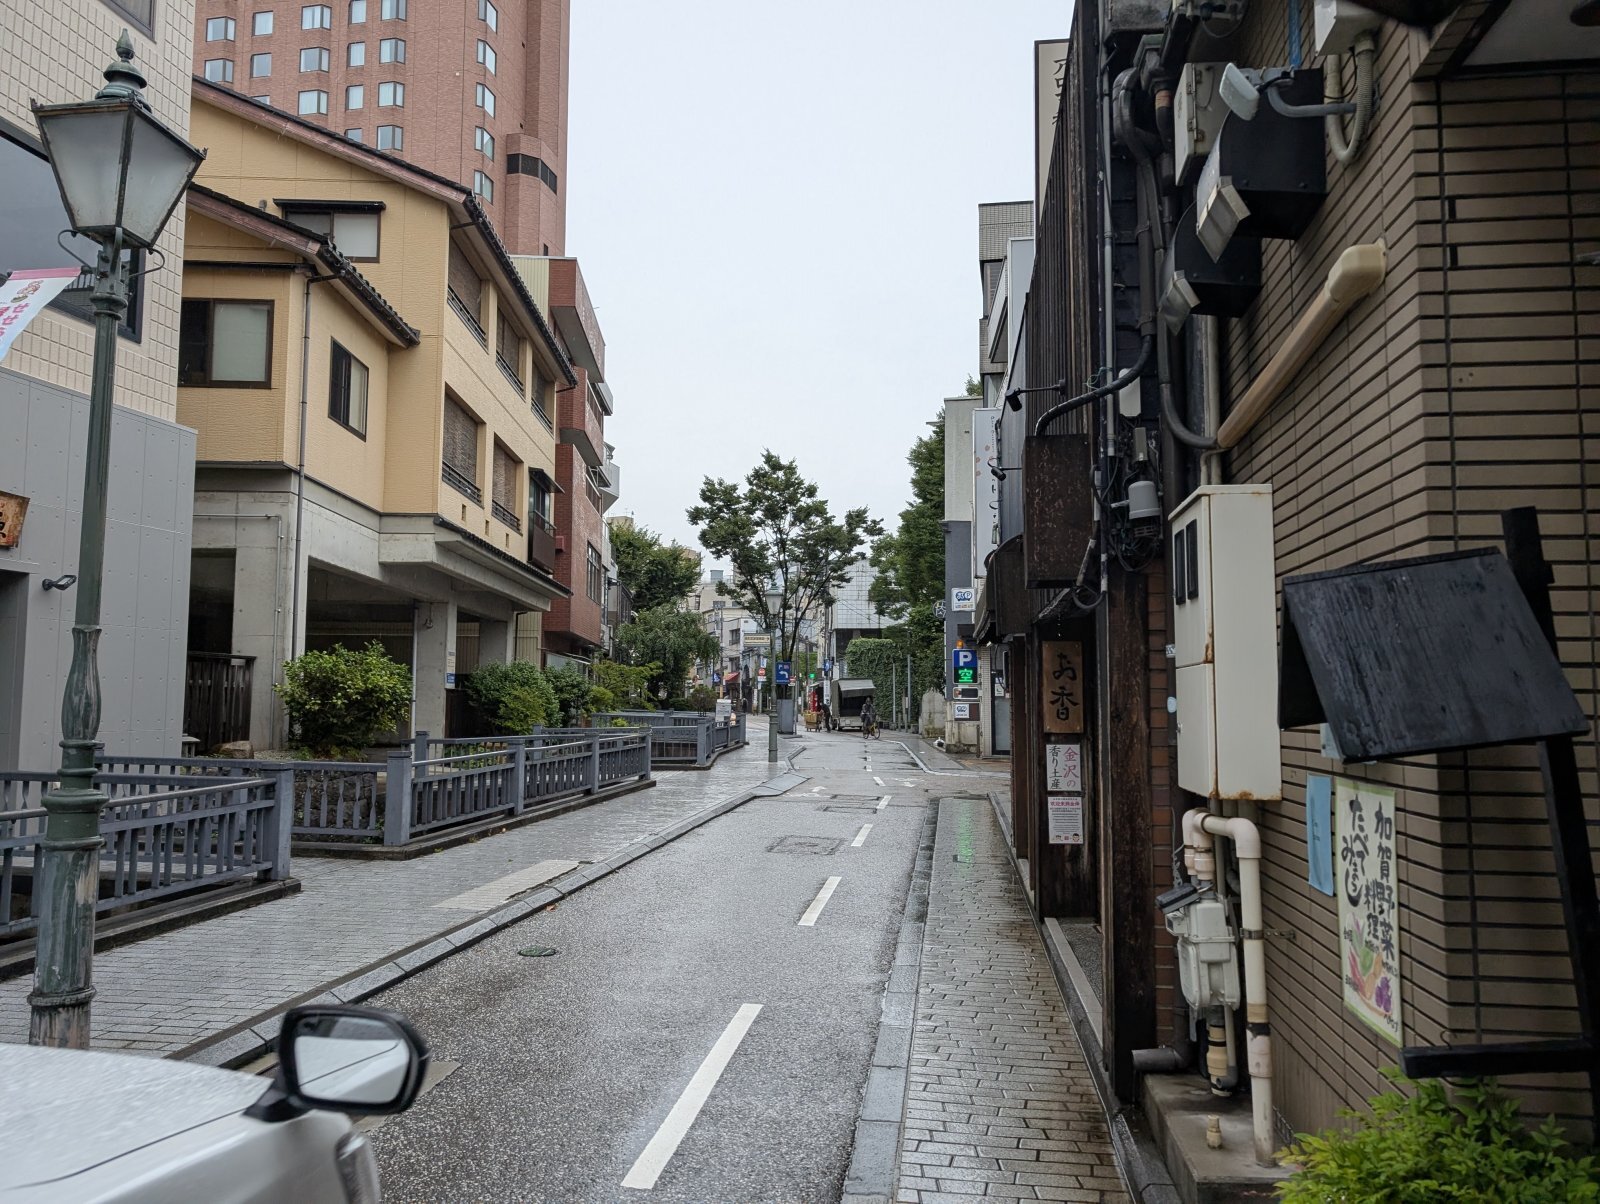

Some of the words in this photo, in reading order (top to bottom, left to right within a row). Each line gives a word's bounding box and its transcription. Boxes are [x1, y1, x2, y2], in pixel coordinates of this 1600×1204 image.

[958, 668, 973, 683] 空
[959, 651, 972, 666] P
[1049, 652, 1080, 722] お香
[1049, 745, 1062, 789] 香り土産
[1063, 746, 1080, 788] 金沢の
